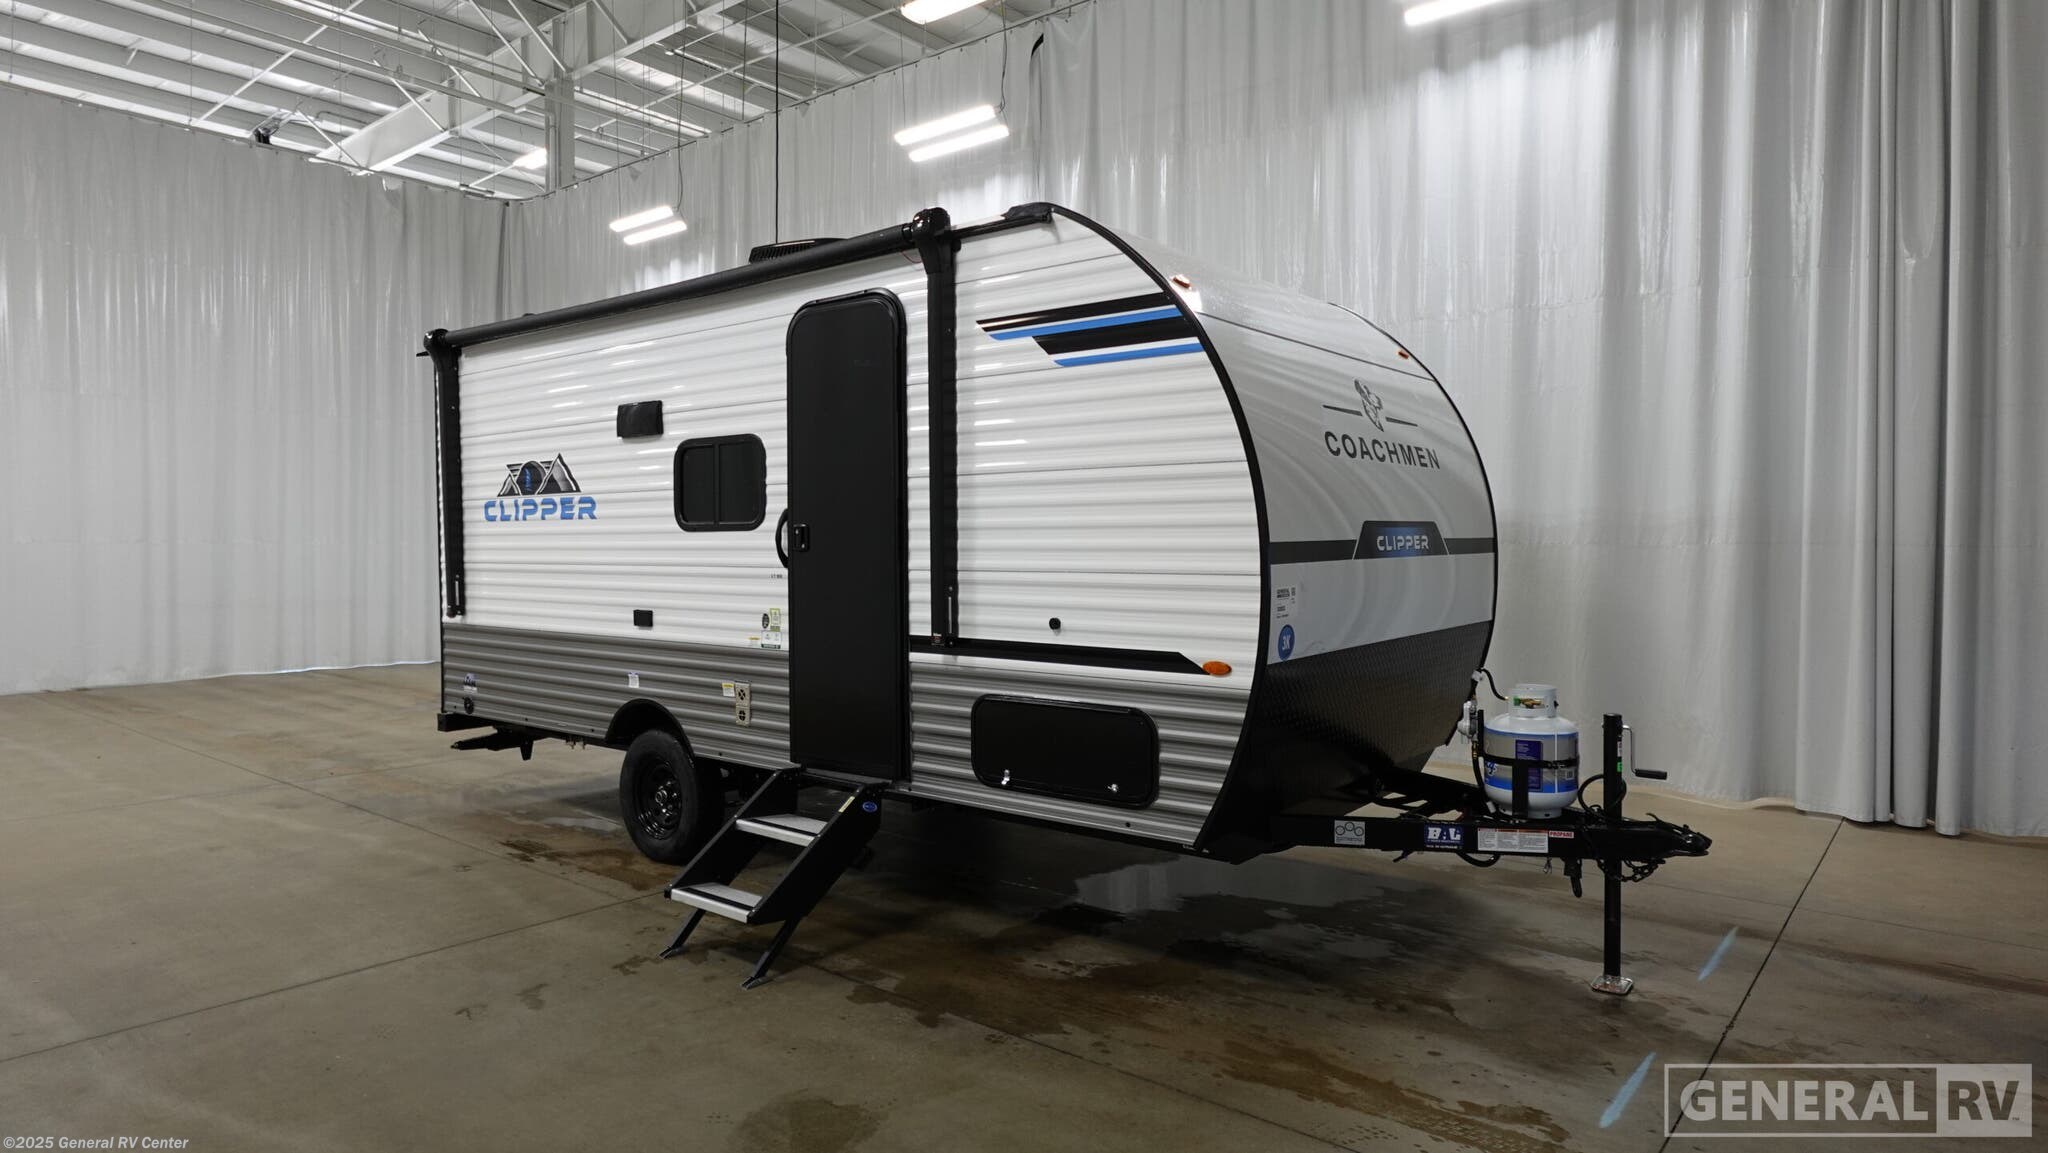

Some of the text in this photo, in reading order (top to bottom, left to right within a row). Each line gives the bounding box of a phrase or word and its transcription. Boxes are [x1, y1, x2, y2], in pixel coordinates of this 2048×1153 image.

[1324, 431, 1441, 469] COACHMEN
[484, 496, 598, 522] CLIPPER
[1376, 535, 1430, 552] CLIPPER
